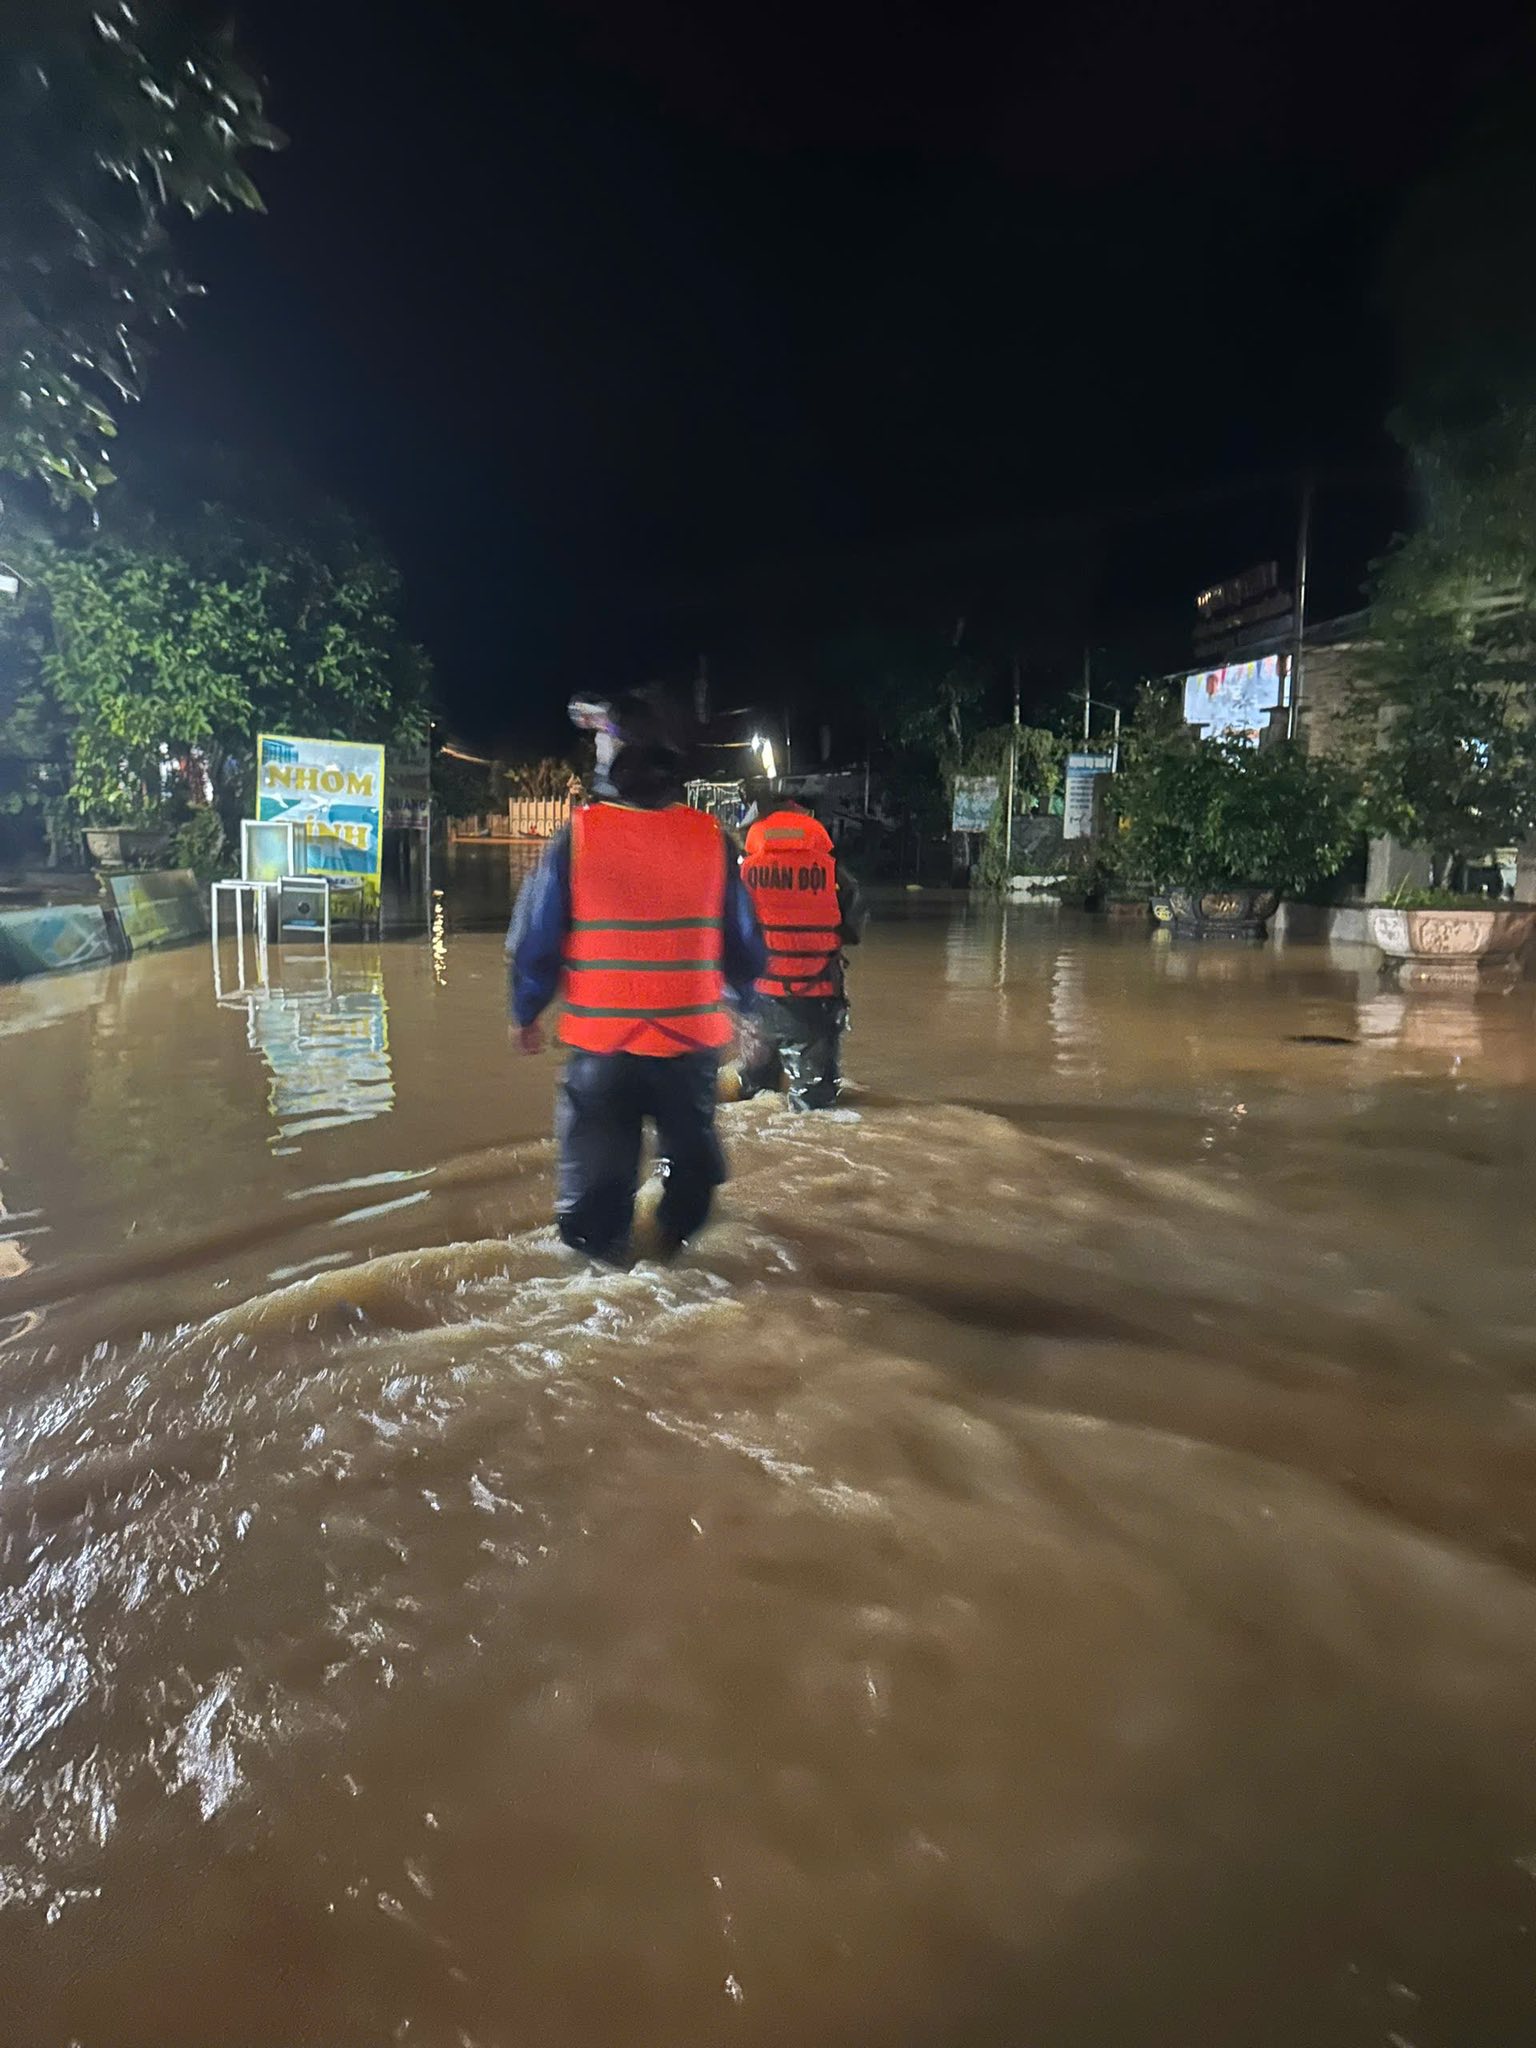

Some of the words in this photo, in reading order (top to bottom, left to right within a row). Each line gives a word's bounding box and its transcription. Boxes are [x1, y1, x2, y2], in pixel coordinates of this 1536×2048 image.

[277, 814, 370, 851] ÍNH
[747, 860, 794, 891] QUÂN
[798, 861, 827, 896] ĐỘI
